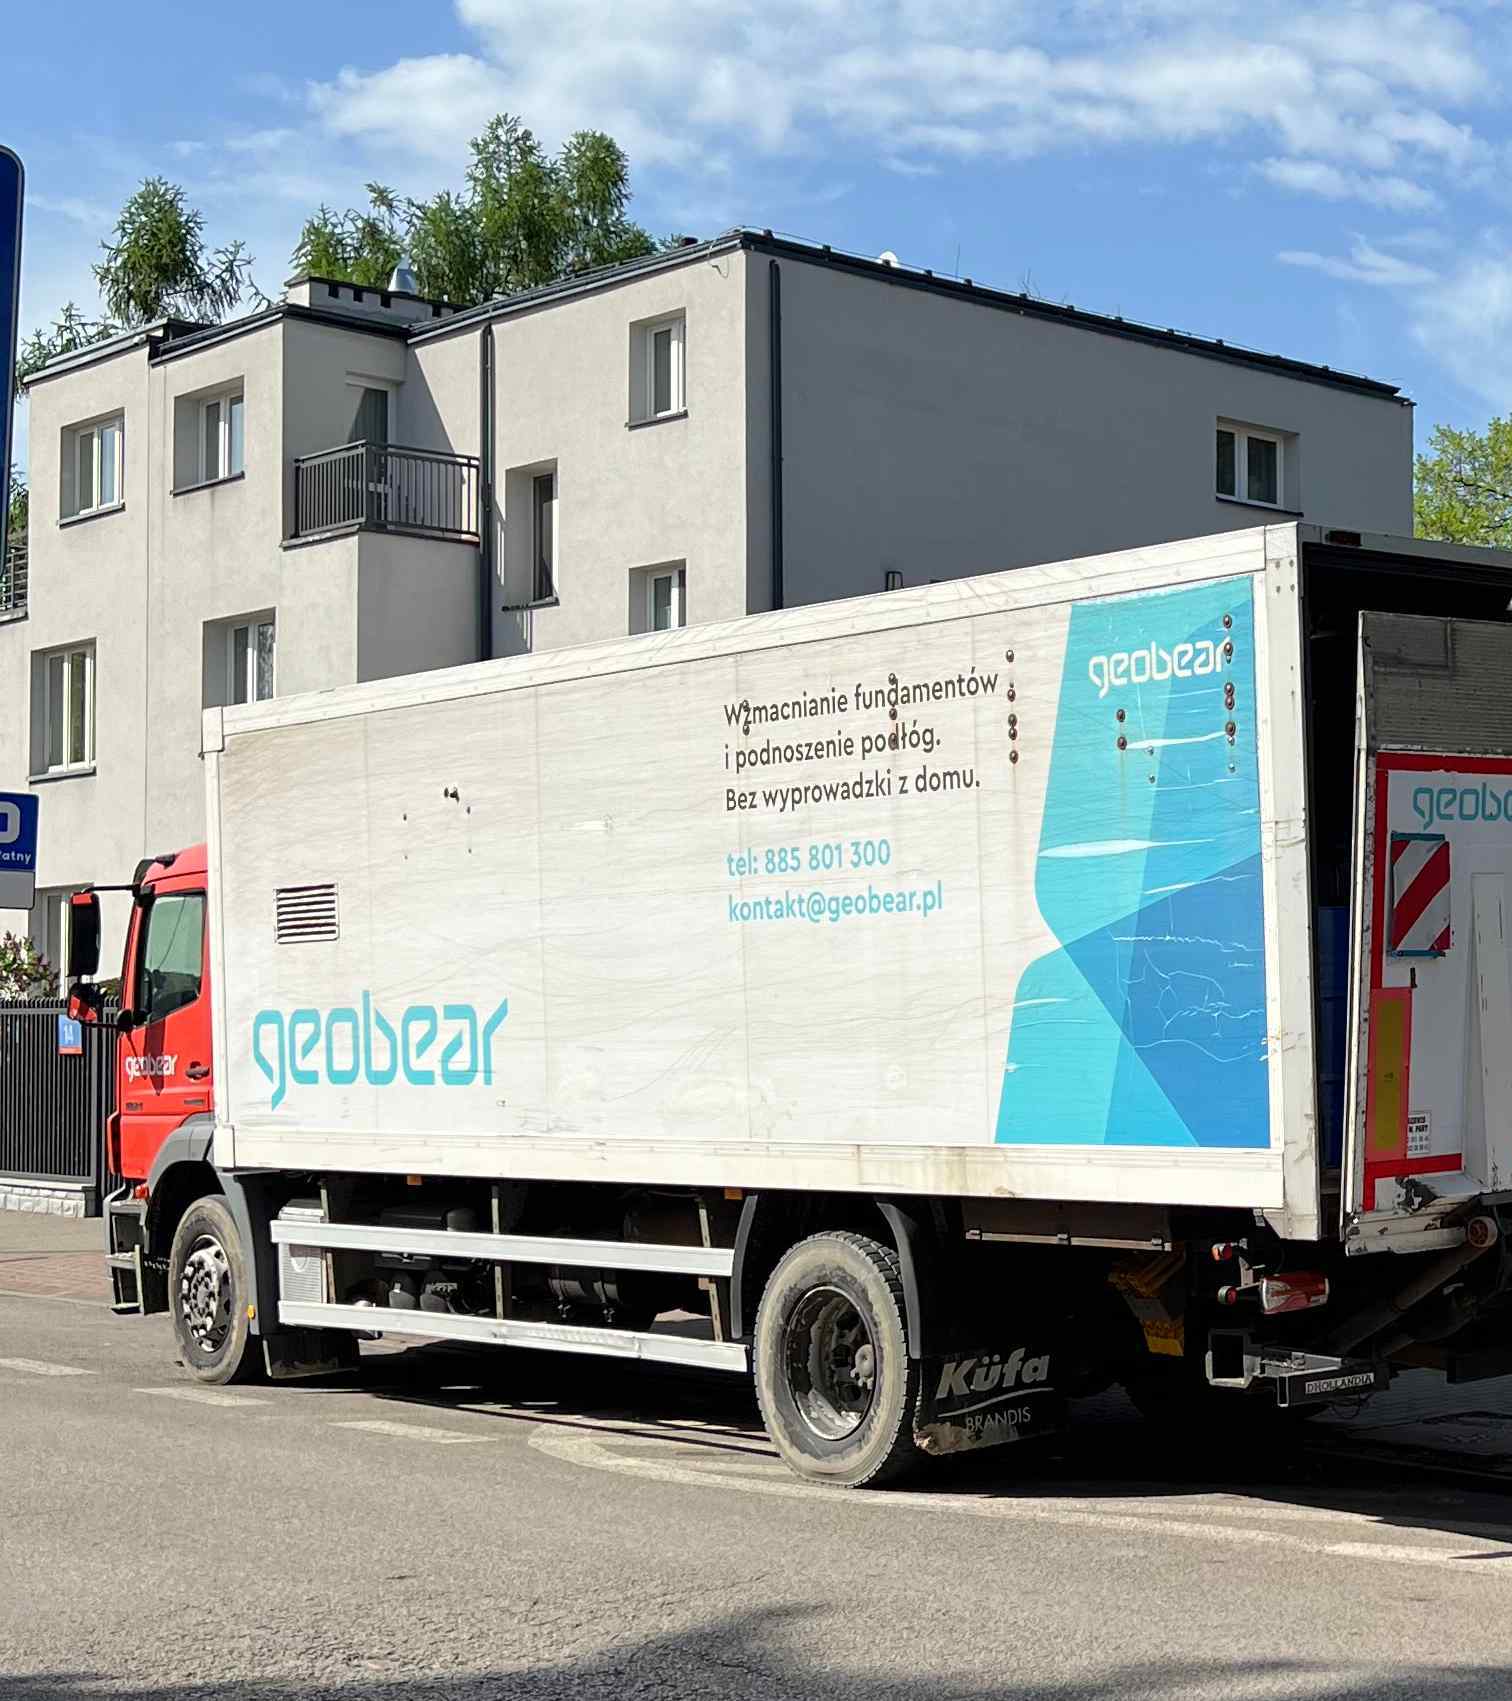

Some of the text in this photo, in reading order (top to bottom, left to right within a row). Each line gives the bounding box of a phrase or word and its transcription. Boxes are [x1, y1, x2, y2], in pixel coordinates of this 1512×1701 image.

[1088, 636, 1231, 699] geobear
[724, 666, 998, 727] Wzmacnianie fundamentów
[725, 720, 941, 773] i podnoszenie podłóg.
[726, 765, 980, 812] Bez wyprowadzki z domu.
[0, 850, 31, 865] atny
[727, 839, 891, 876] tel: 885 801 300
[728, 880, 942, 923] kontakt@geobear.pl
[125, 1055, 178, 1082] geobear
[253, 990, 509, 1112] geobear
[935, 1347, 1050, 1400] Küfa
[1306, 1374, 1373, 1393] DHOLLANDIA
[966, 1406, 1031, 1431] BRANDIS
